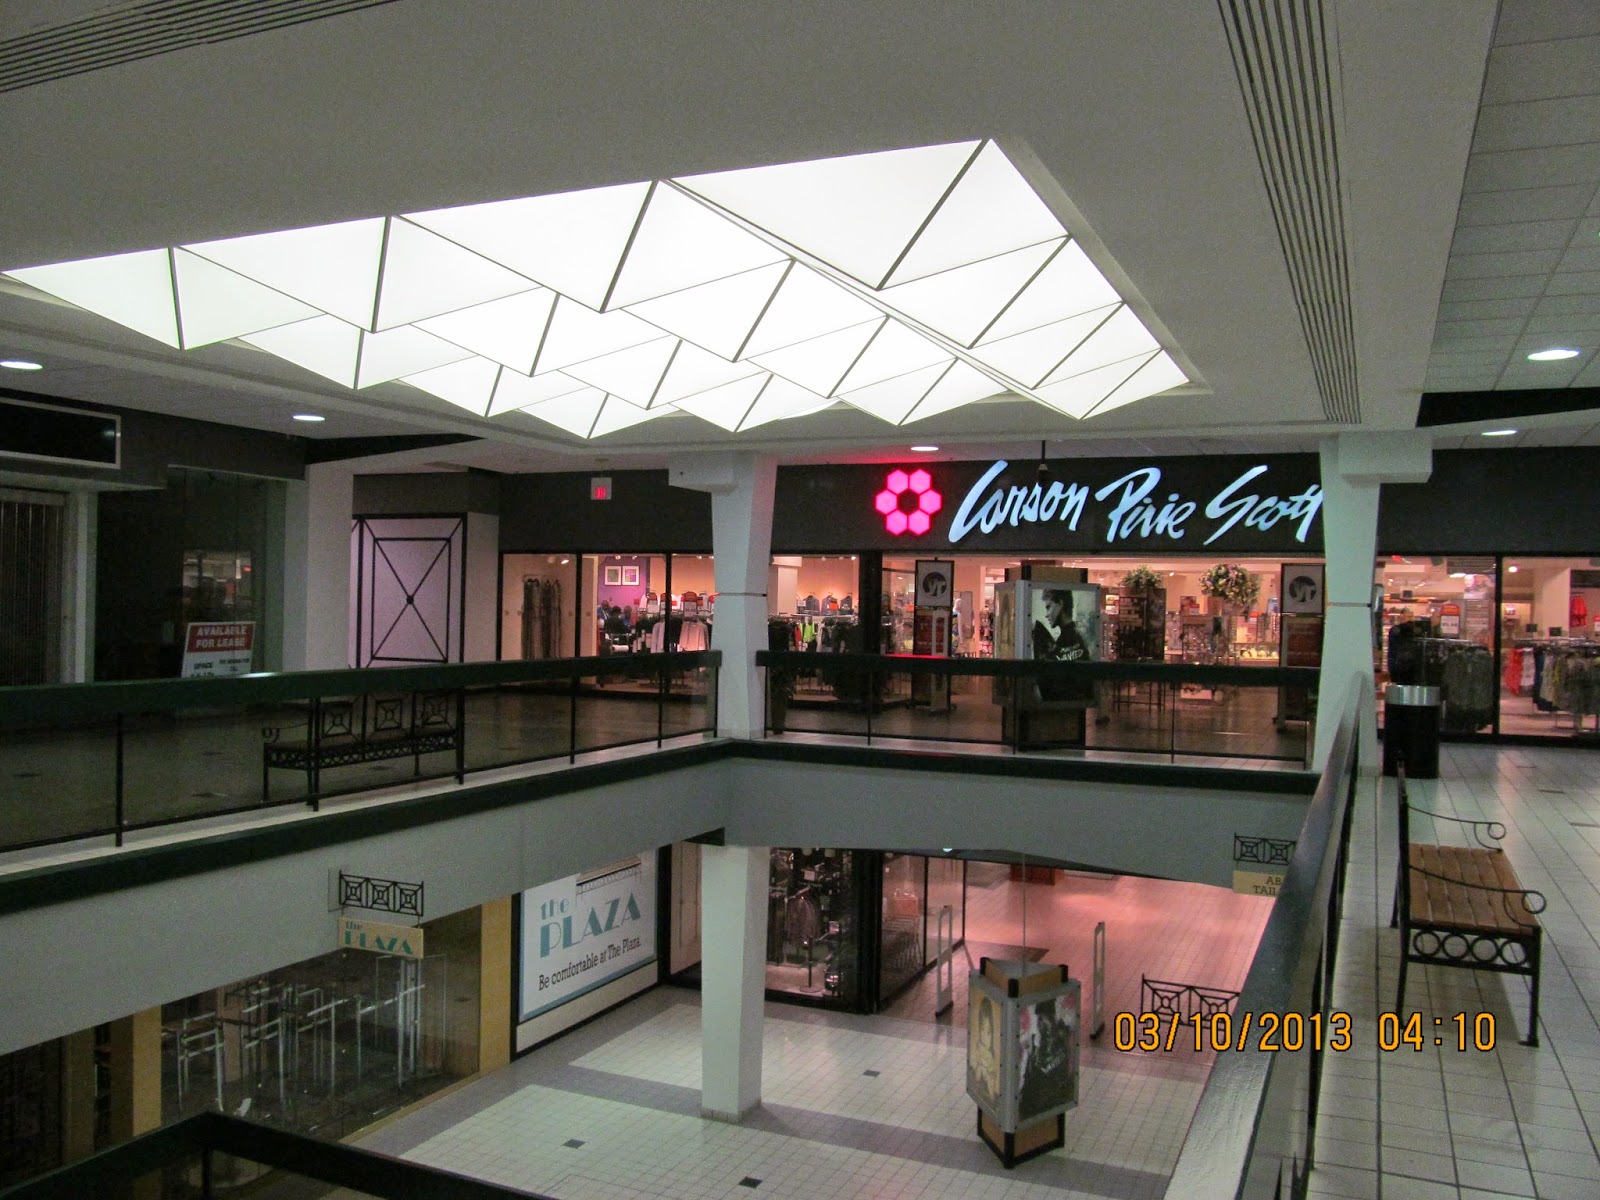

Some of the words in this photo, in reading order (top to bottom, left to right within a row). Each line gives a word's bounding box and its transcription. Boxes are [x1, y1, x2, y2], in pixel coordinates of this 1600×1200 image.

[948, 460, 1090, 543] Carson
[1095, 466, 1196, 543] Pirie
[1204, 464, 1324, 545] Scott
[195, 638, 215, 649] FOR
[217, 637, 246, 648] LEASE
[197, 625, 248, 637] AVAILABLE
[541, 898, 570, 920] the
[540, 892, 641, 958] PLAZA
[344, 930, 413, 955] PLAZA
[538, 974, 550, 991] Be
[551, 952, 599, 985] comfortable
[599, 949, 607, 963] at
[607, 943, 621, 960] The
